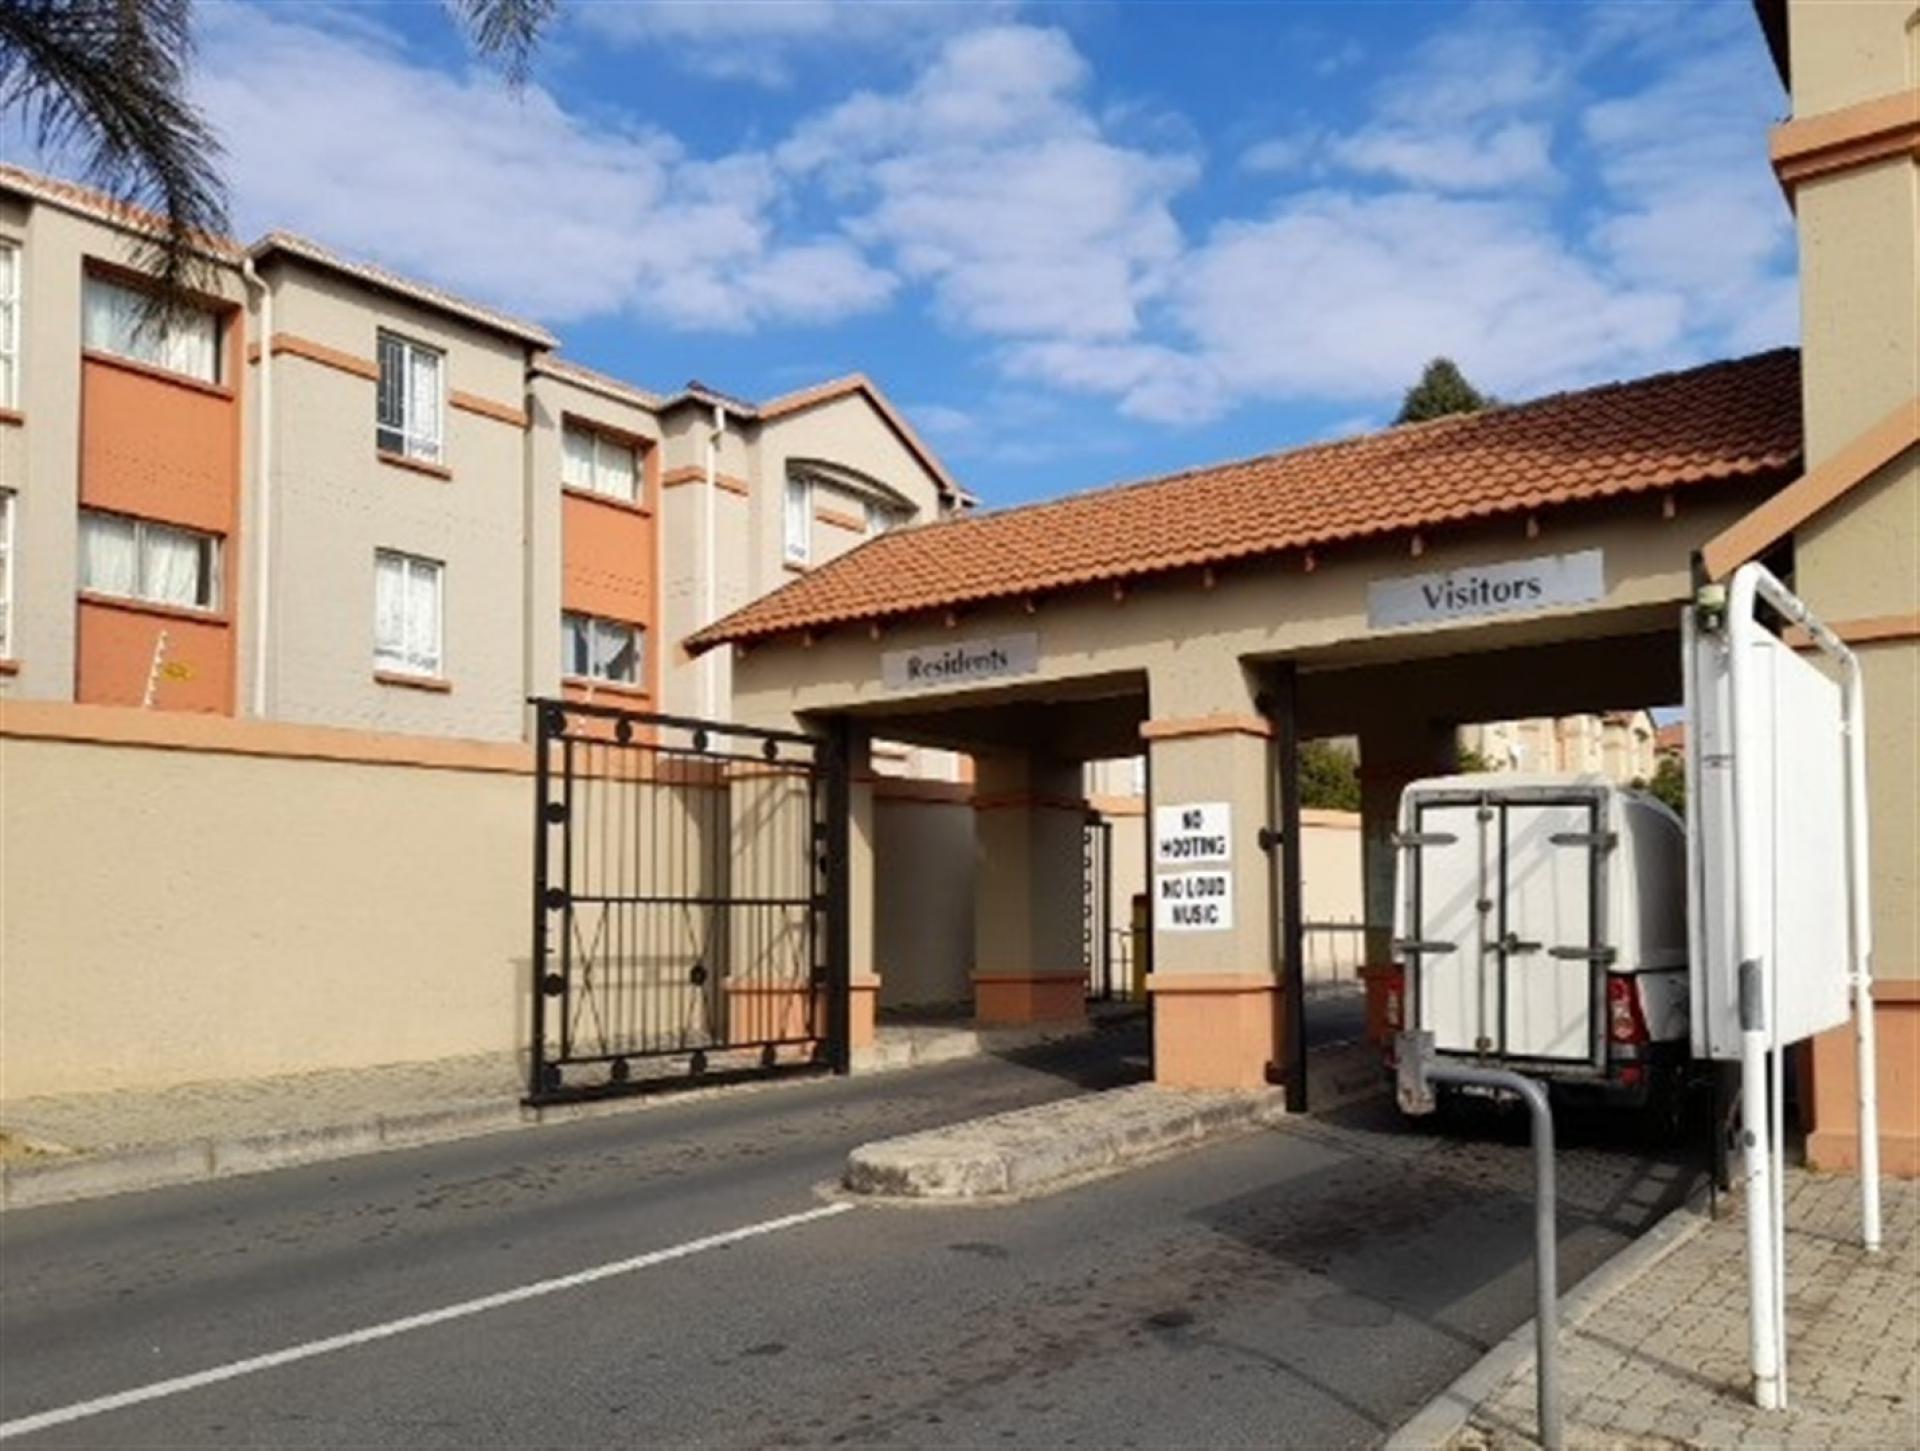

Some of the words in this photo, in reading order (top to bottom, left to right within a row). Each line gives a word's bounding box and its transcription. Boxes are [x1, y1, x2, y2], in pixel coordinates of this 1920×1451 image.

[1421, 576, 1542, 609] Visitors
[908, 647, 1007, 679] Residents
[1182, 809, 1203, 830] NO
[1160, 835, 1226, 858] HOOTING
[1162, 878, 1183, 899] NO
[1186, 877, 1226, 899] LOUD
[1173, 903, 1219, 925] MUSIC
